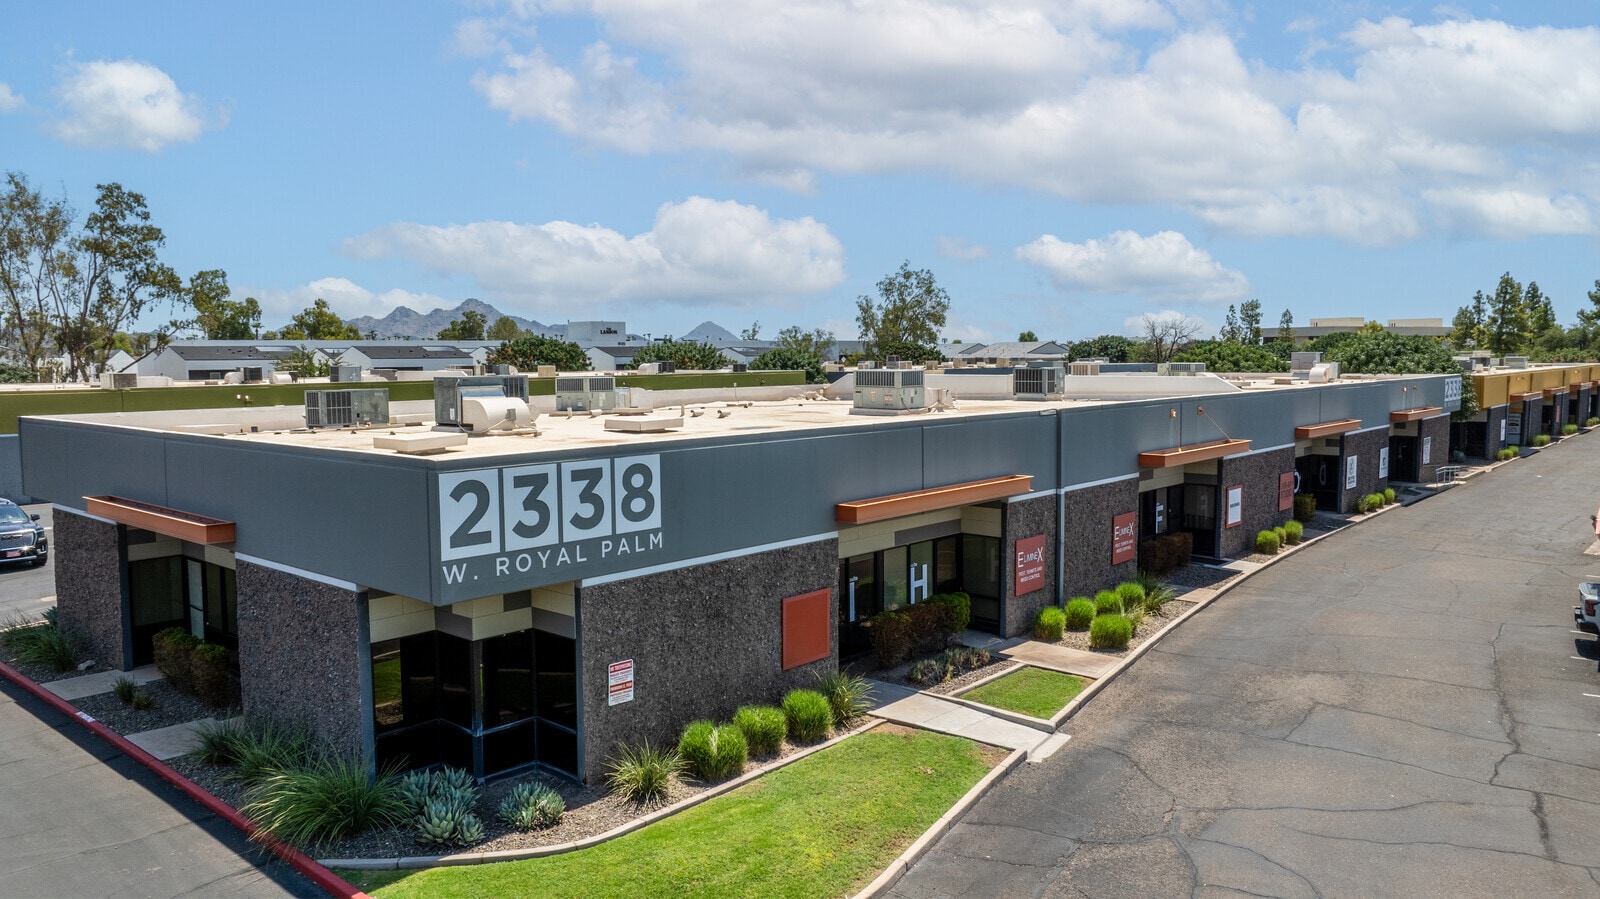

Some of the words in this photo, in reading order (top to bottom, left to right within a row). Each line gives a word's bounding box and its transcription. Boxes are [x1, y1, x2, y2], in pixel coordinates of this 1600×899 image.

[449, 463, 655, 549] 2338
[1156, 505, 1163, 534] F
[442, 563, 479, 585] W.
[496, 545, 587, 577] ROYAL
[602, 532, 663, 558] PALM
[910, 563, 928, 604] H
